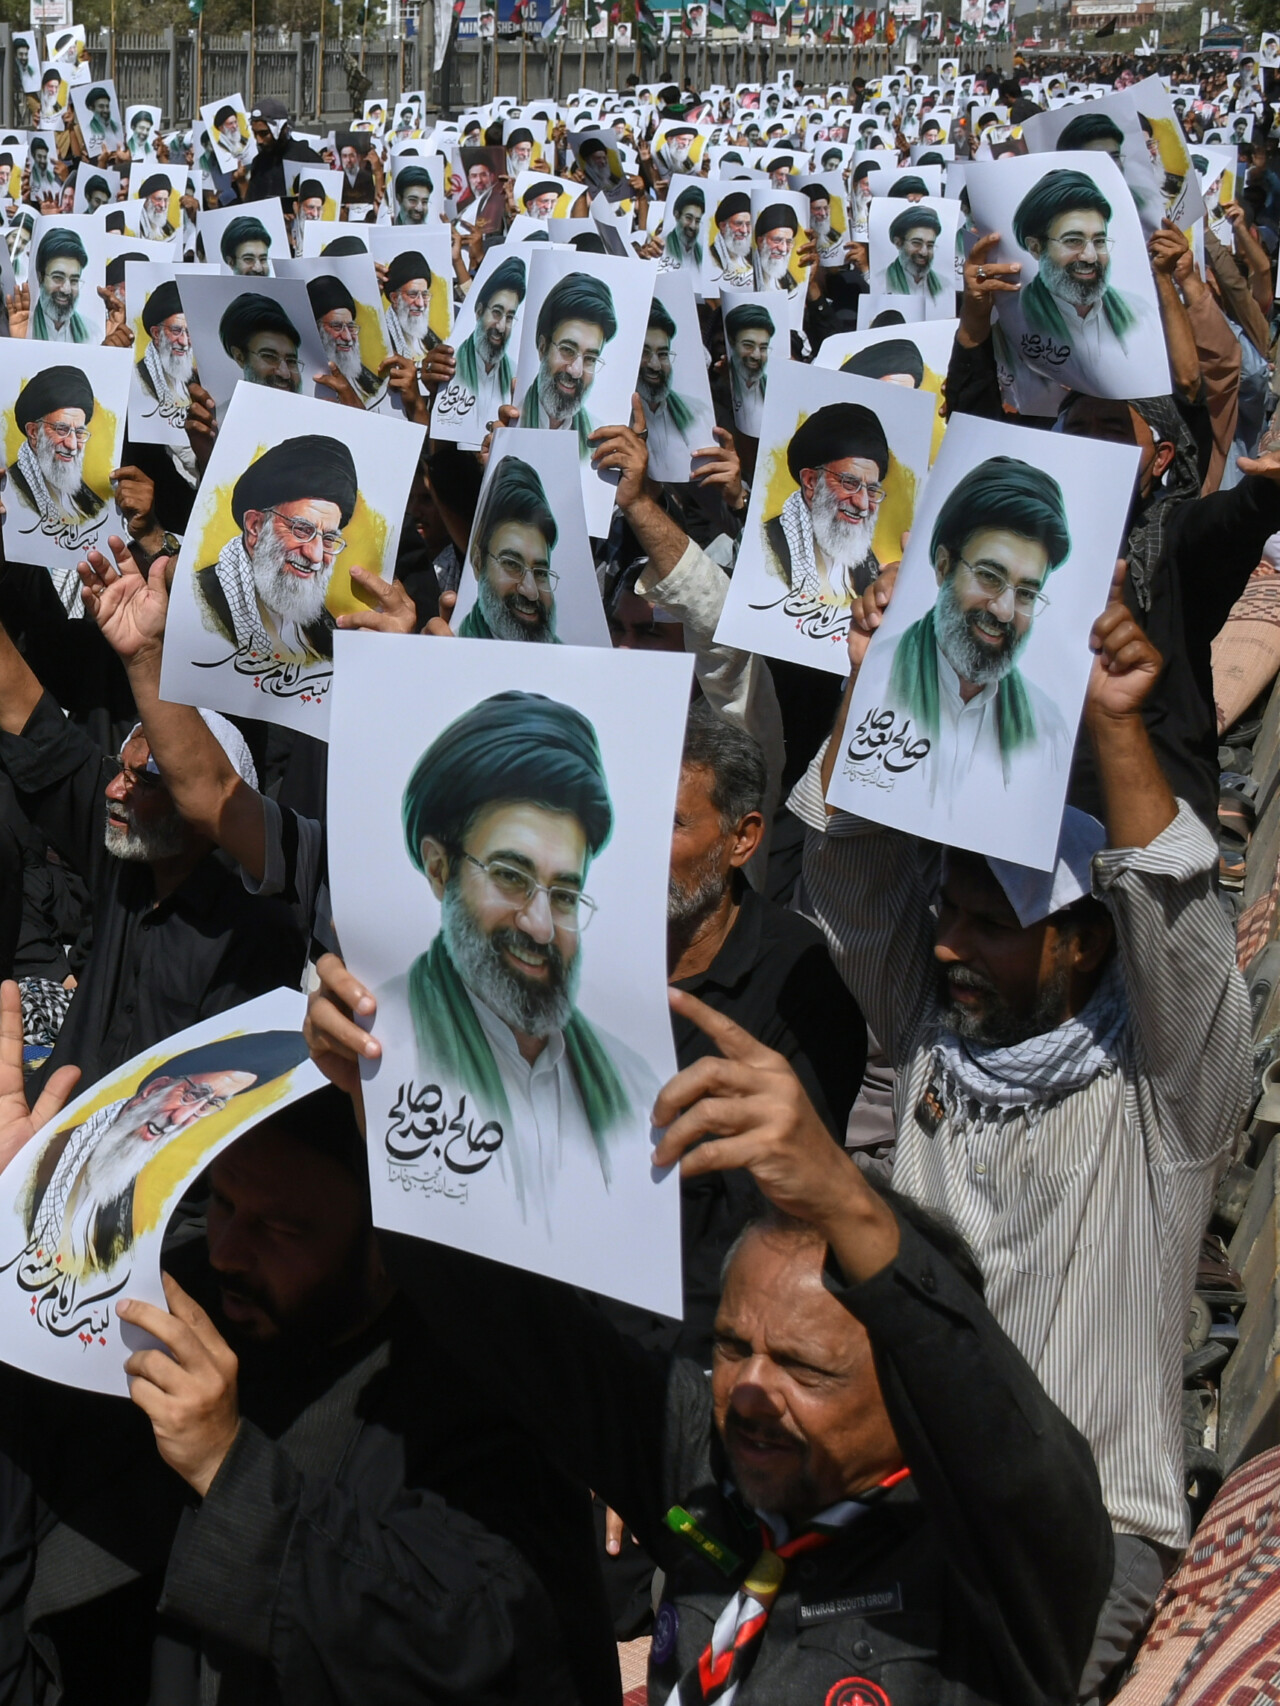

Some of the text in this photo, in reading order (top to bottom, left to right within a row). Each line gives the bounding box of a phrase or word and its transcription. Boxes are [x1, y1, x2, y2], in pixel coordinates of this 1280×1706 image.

[1021, 334, 1070, 365] صالح بعد صالح
[437, 386, 475, 415] صالح بعد صالح
[847, 706, 931, 773] صالح بعد صالح
[385, 1080, 504, 1174] صالح بعد صالح
[36, 1272, 79, 1330] امام
[46, 1269, 132, 1347] لبیک
[801, 1592, 895, 1617] BUTURAB SCOUTS GROUP
